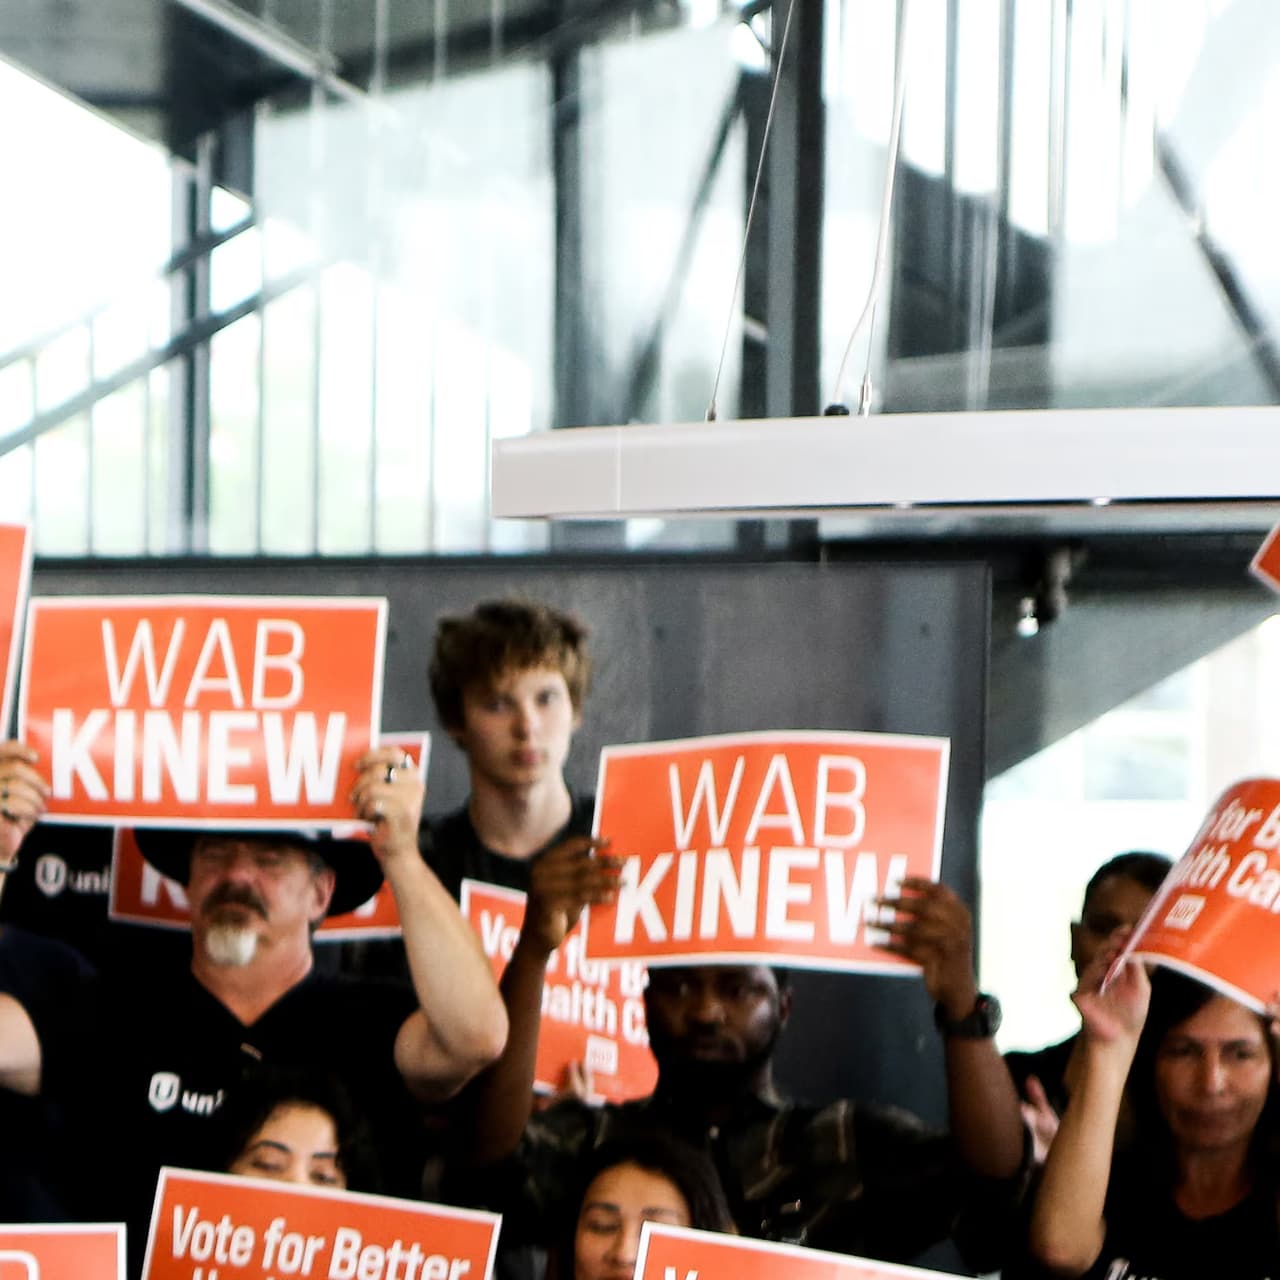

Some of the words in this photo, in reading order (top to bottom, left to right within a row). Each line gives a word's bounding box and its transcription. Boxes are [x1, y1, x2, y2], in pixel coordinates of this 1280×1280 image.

[100, 617, 306, 711] WAB
[50, 708, 347, 805] KINEW
[668, 753, 869, 851] WAB
[612, 844, 908, 946] KINEW
[1226, 850, 1280, 914] Ca
[171, 1204, 256, 1267] Vote
[262, 1216, 325, 1275] for
